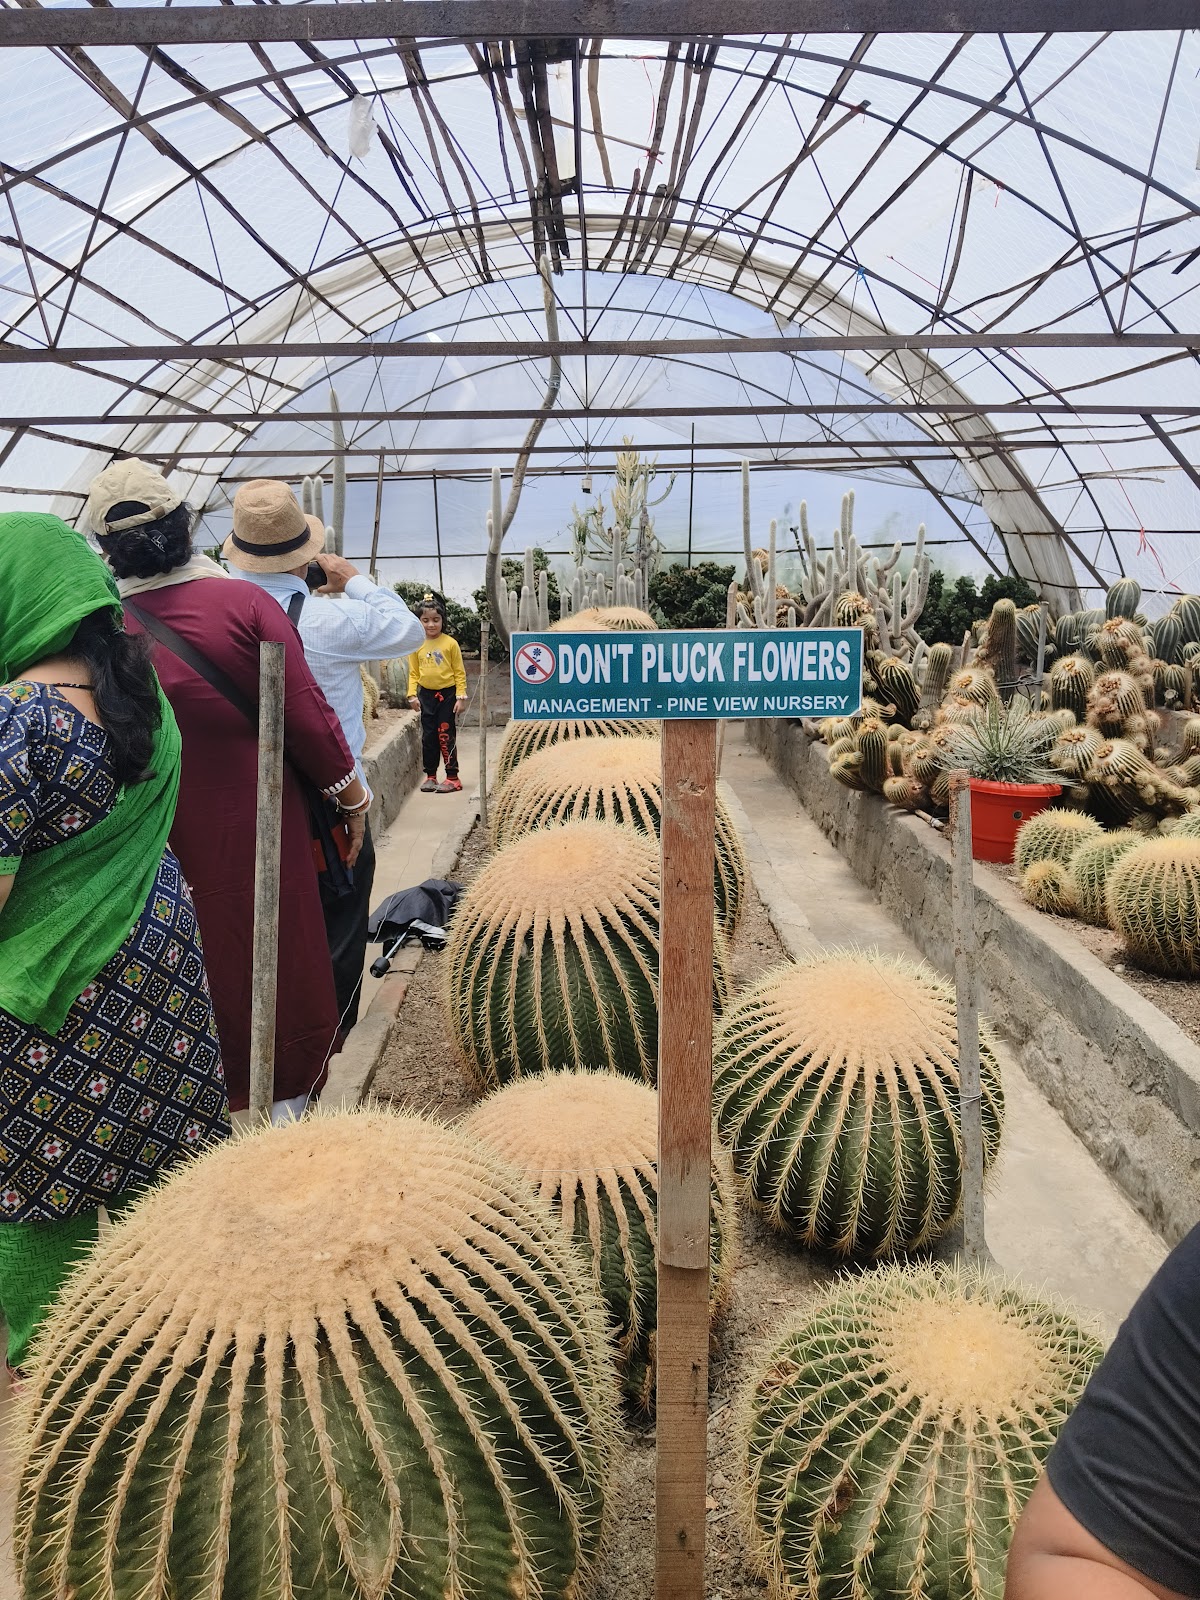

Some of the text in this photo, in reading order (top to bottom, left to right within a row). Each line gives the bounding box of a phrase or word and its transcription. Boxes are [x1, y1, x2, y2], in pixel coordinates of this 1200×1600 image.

[558, 640, 851, 684] DON'T PLUCK FLOWERS
[523, 698, 652, 713] MANAGEMENT
[667, 697, 708, 712] PINE
[712, 696, 759, 711] VIEW
[763, 695, 849, 711] NURSERY
